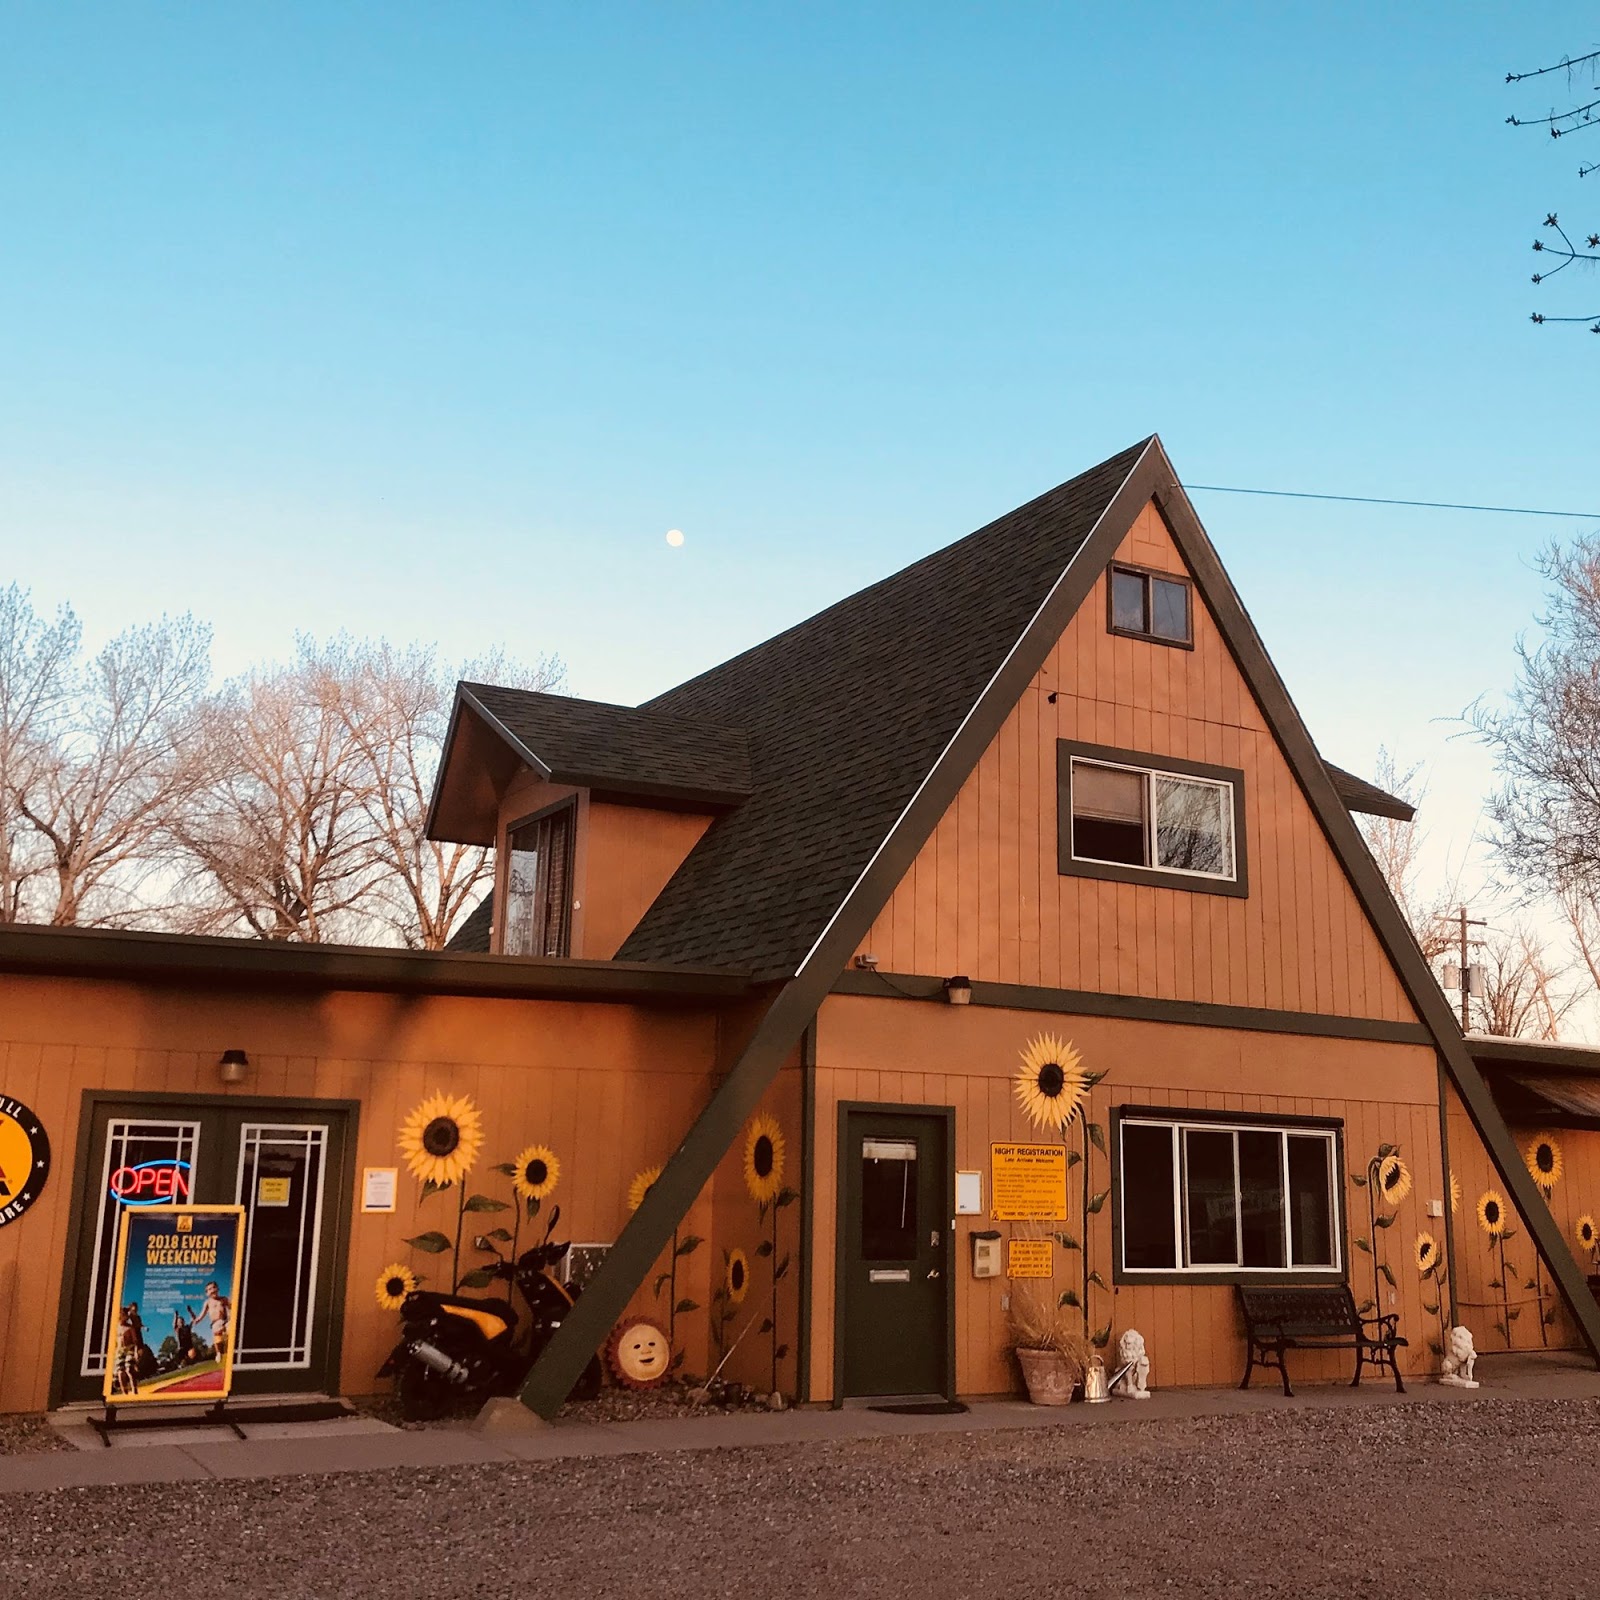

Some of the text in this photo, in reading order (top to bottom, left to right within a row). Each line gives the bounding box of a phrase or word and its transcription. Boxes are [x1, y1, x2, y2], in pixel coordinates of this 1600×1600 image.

[1018, 1148, 1063, 1156] REGISTRATION
[111, 1167, 189, 1196] OPEN
[147, 1235, 219, 1249] 2018 EVENT
[146, 1249, 217, 1265] WEEKENDS
